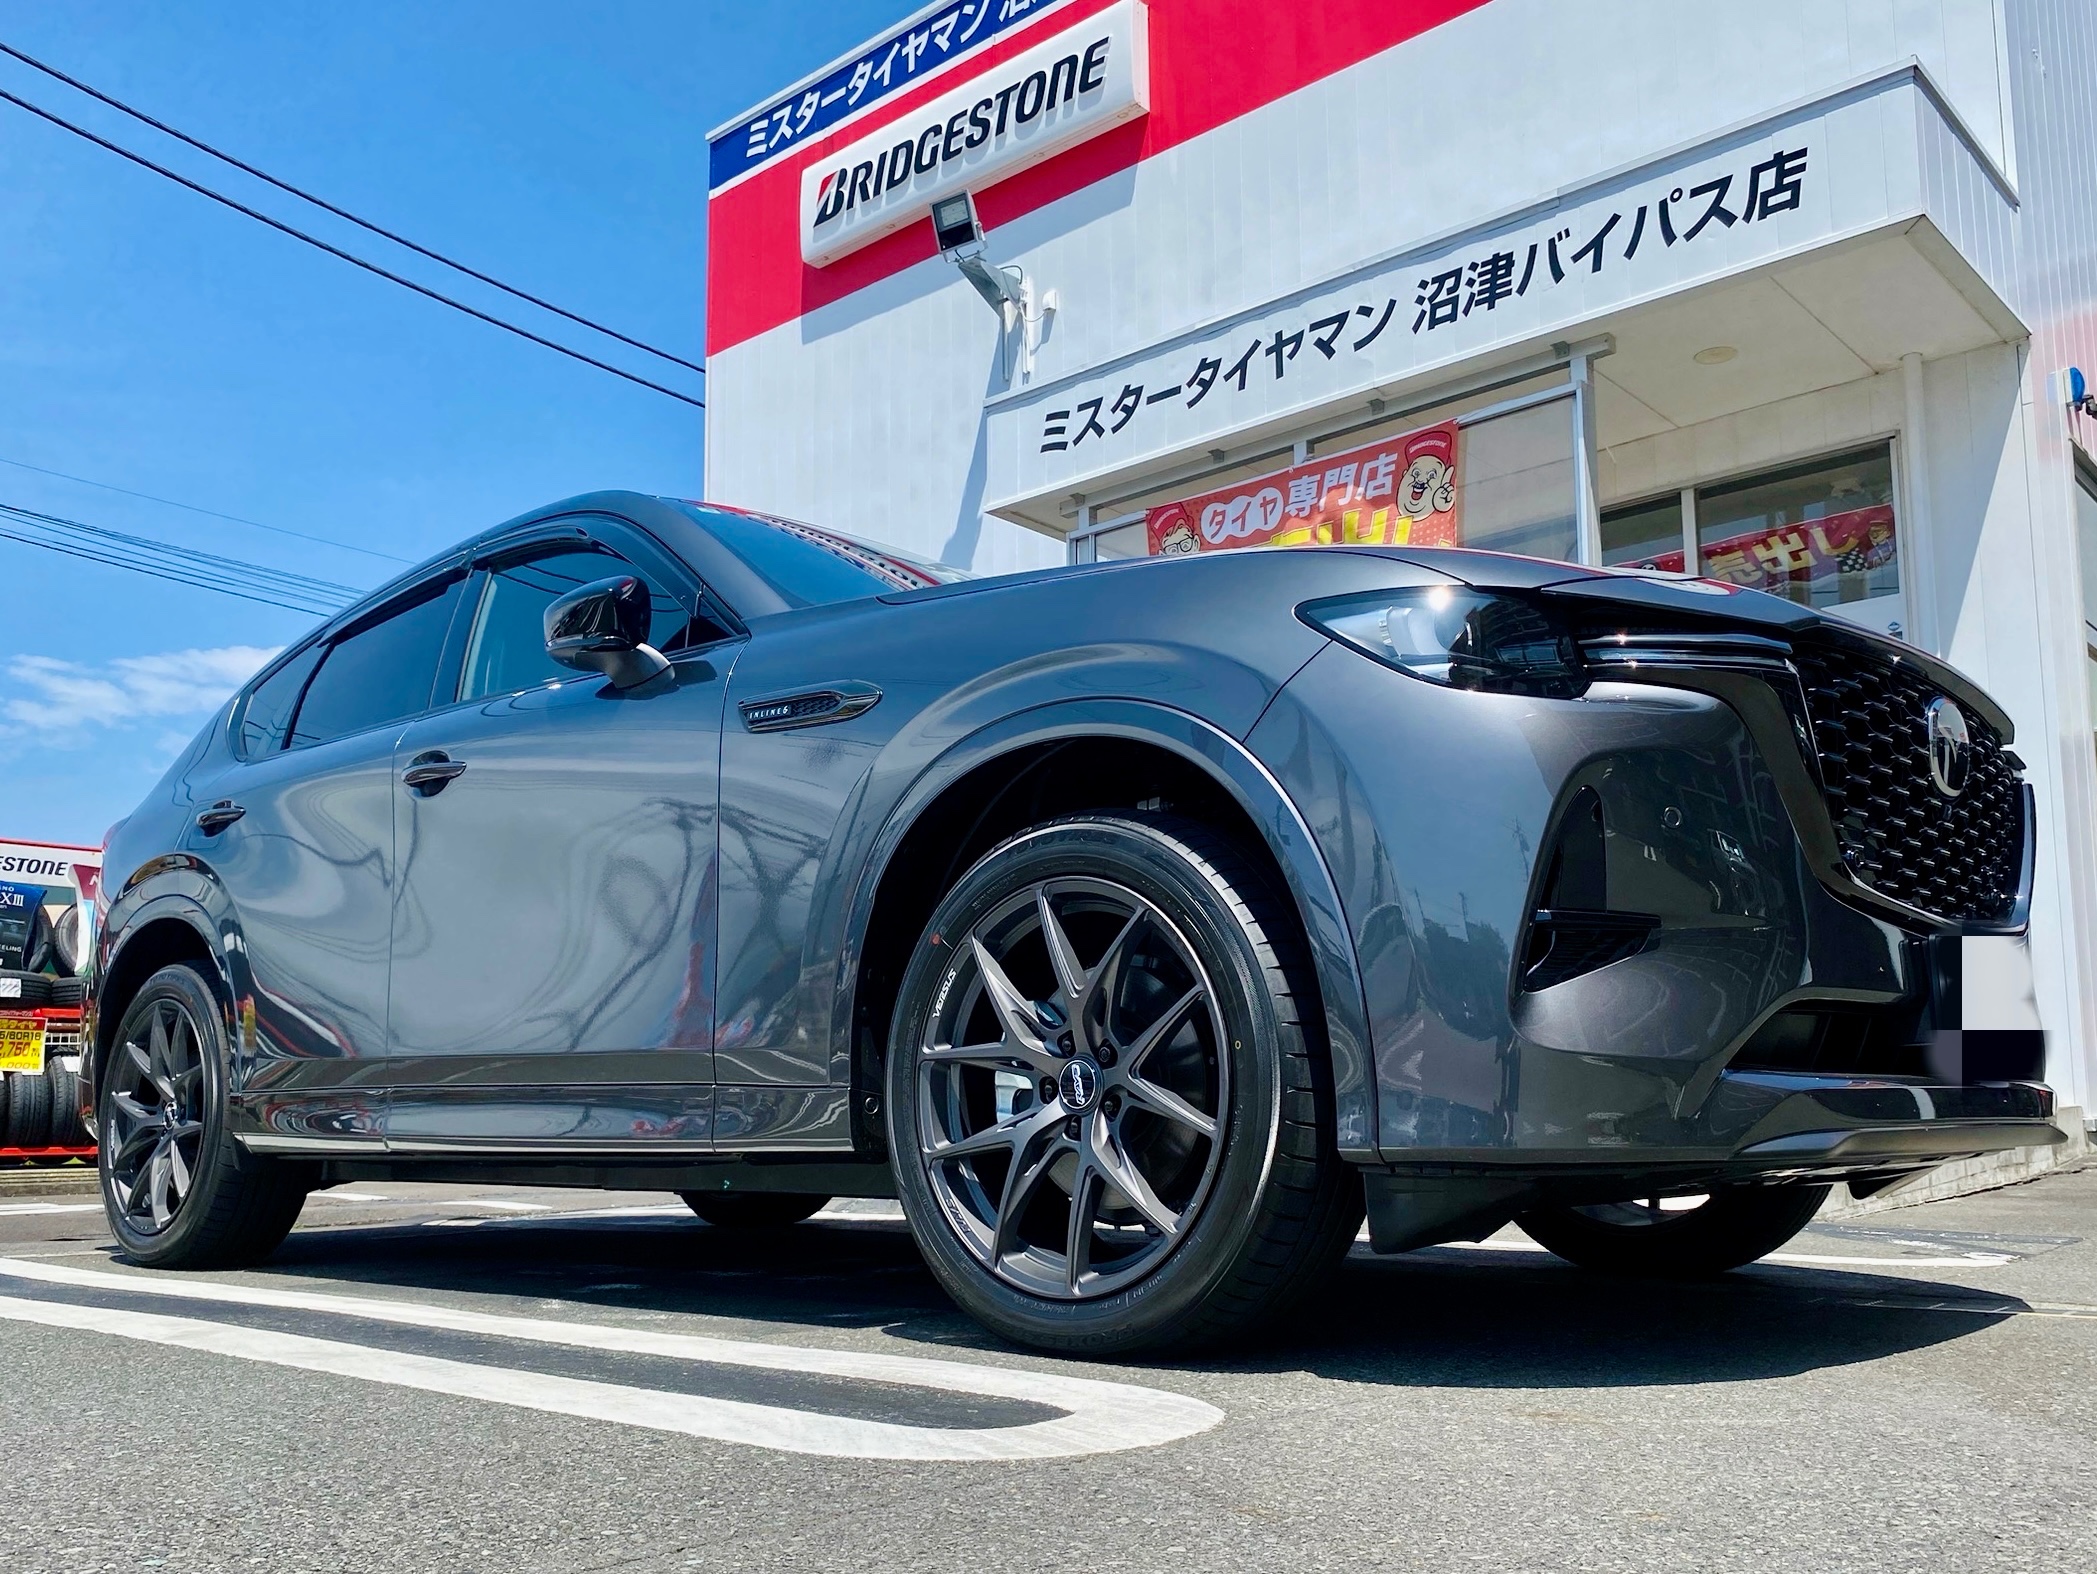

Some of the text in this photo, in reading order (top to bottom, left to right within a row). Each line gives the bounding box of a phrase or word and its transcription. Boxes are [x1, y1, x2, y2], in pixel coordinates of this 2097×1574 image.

[746, 0, 990, 158] ミスタータイヤマン
[813, 35, 1111, 228] BRIDGESTONE
[1039, 146, 1809, 454] ミスタータイヤマン 沼津バイパス店
[932, 967, 957, 1018] VERSUS
